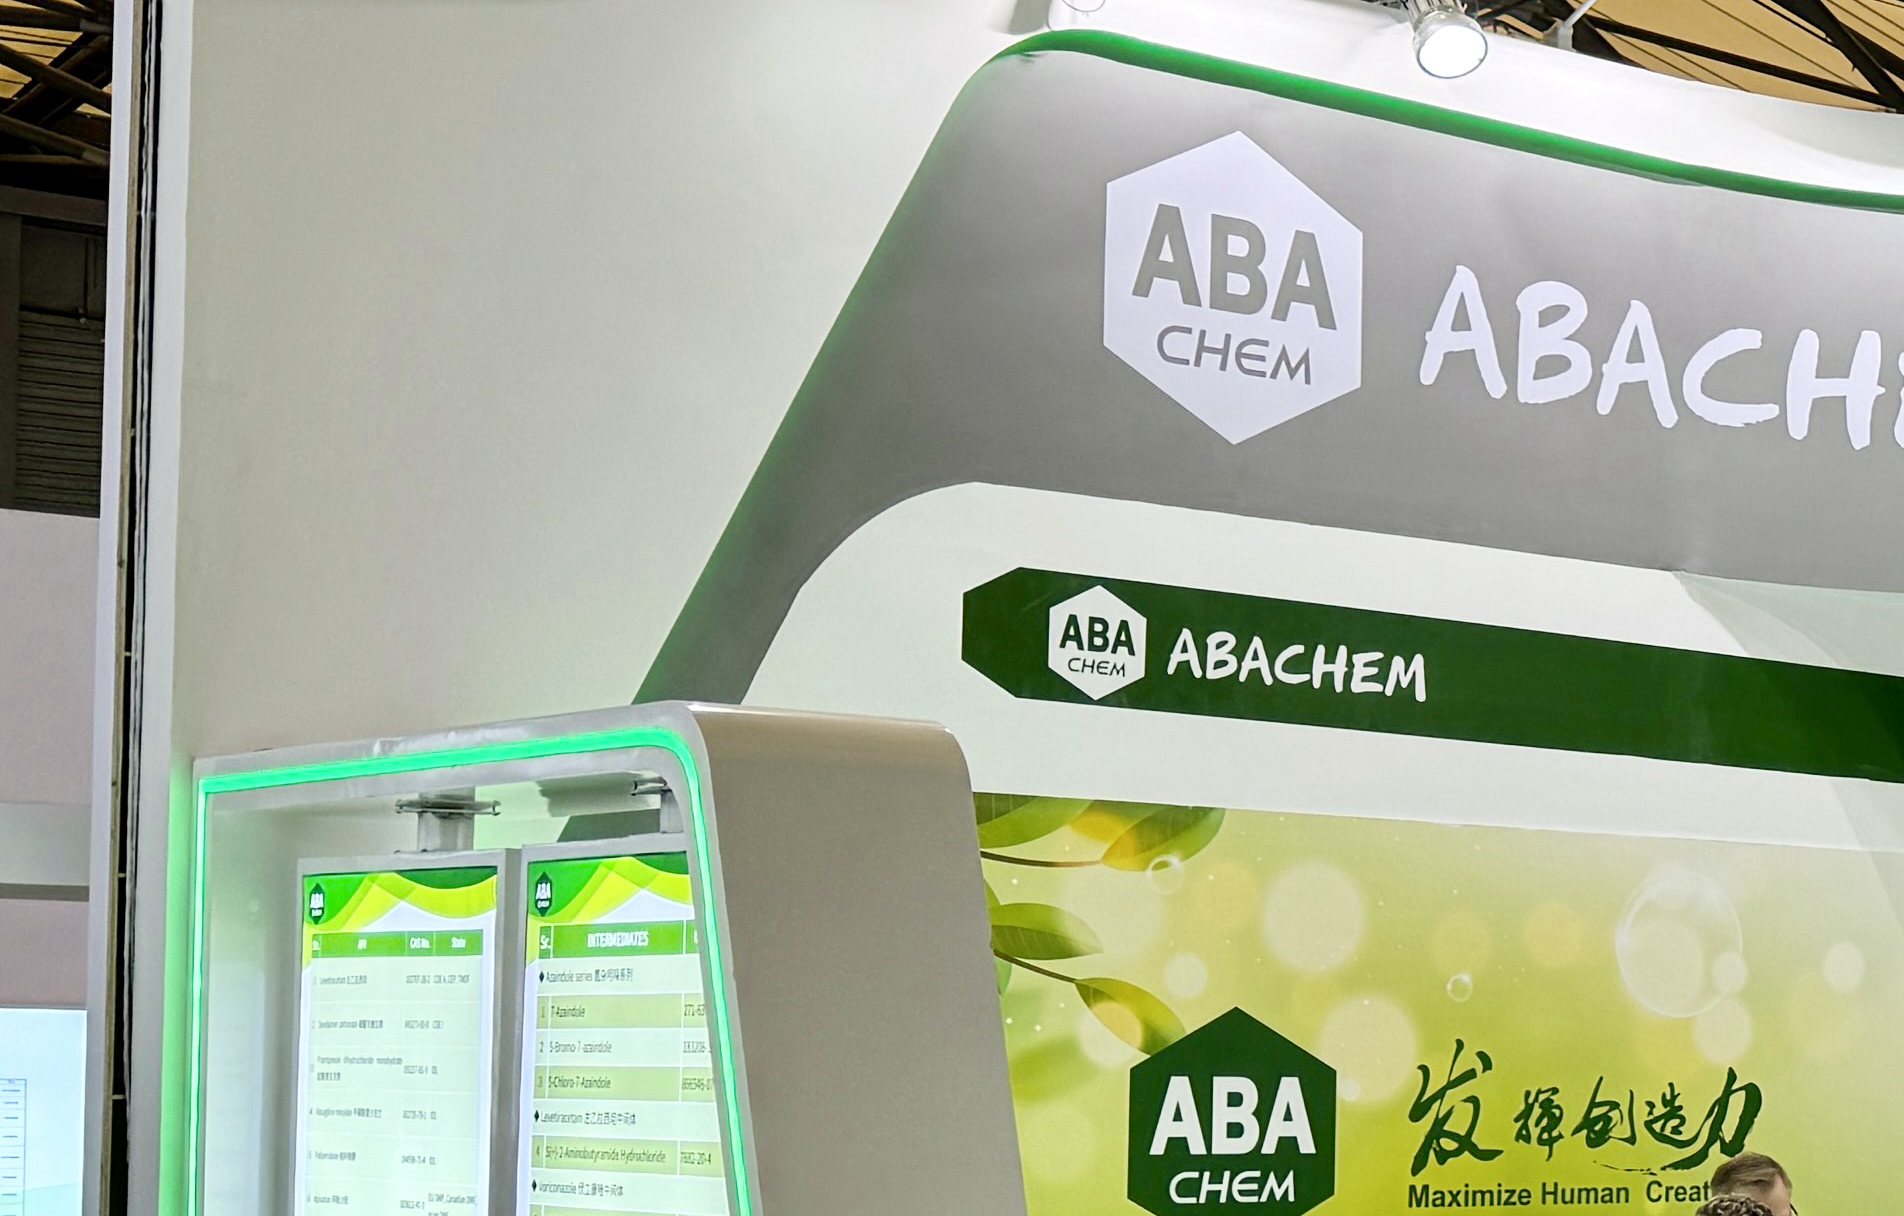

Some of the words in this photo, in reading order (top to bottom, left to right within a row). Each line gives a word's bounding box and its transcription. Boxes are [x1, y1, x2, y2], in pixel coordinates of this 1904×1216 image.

[1131, 204, 1337, 330] ABA
[1156, 325, 1312, 386] CHEM
[1059, 614, 1135, 656] ABA
[1068, 657, 1126, 678] CHEM
[1167, 628, 1426, 702] ABACHEM
[1149, 1075, 1316, 1156] ABA
[1169, 1170, 1296, 1205] CHEM
[1408, 1181, 1532, 1209] Maximize
[1541, 1180, 1630, 1206] Human
[1645, 1179, 1712, 1204] Creat
